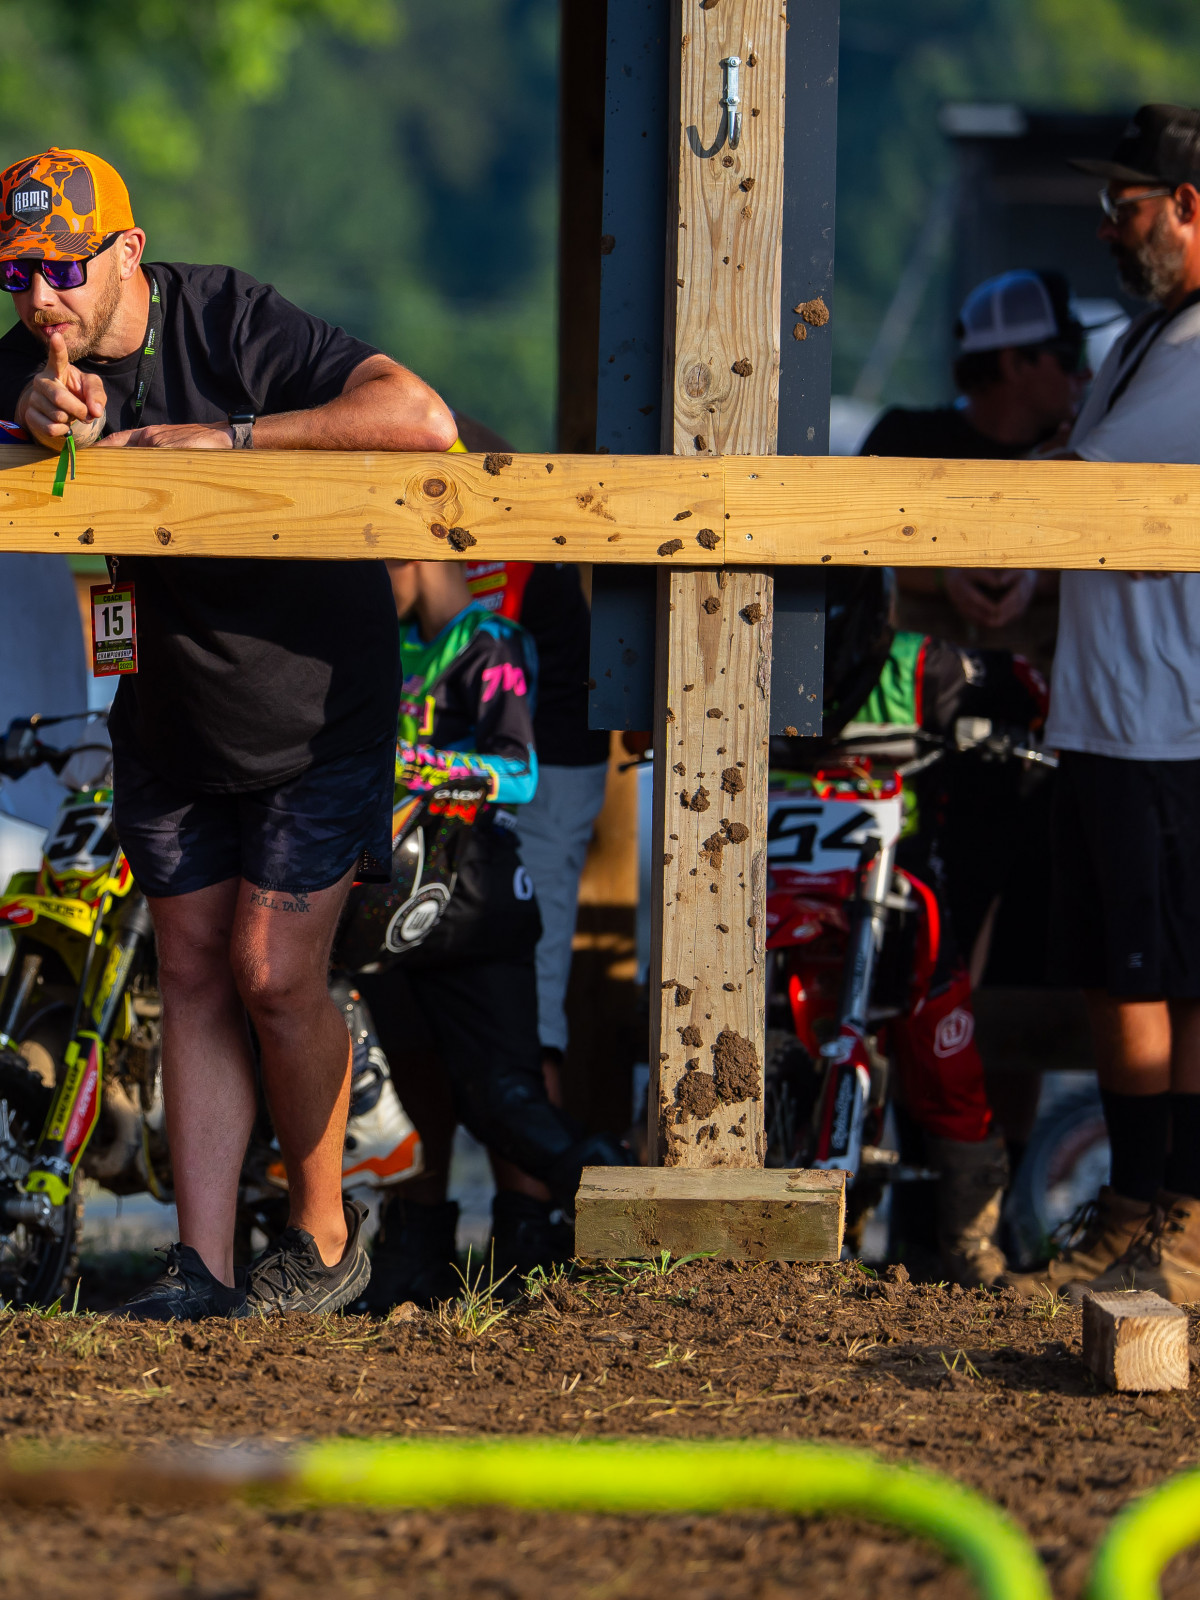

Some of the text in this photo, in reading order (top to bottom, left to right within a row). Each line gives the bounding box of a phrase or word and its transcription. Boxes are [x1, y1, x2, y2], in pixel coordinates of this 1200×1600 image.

[103, 594, 123, 603] COACH
[101, 605, 124, 637] 15
[97, 649, 132, 660] CHAMPIONSHIP
[250, 892, 311, 912] FULL TANK
